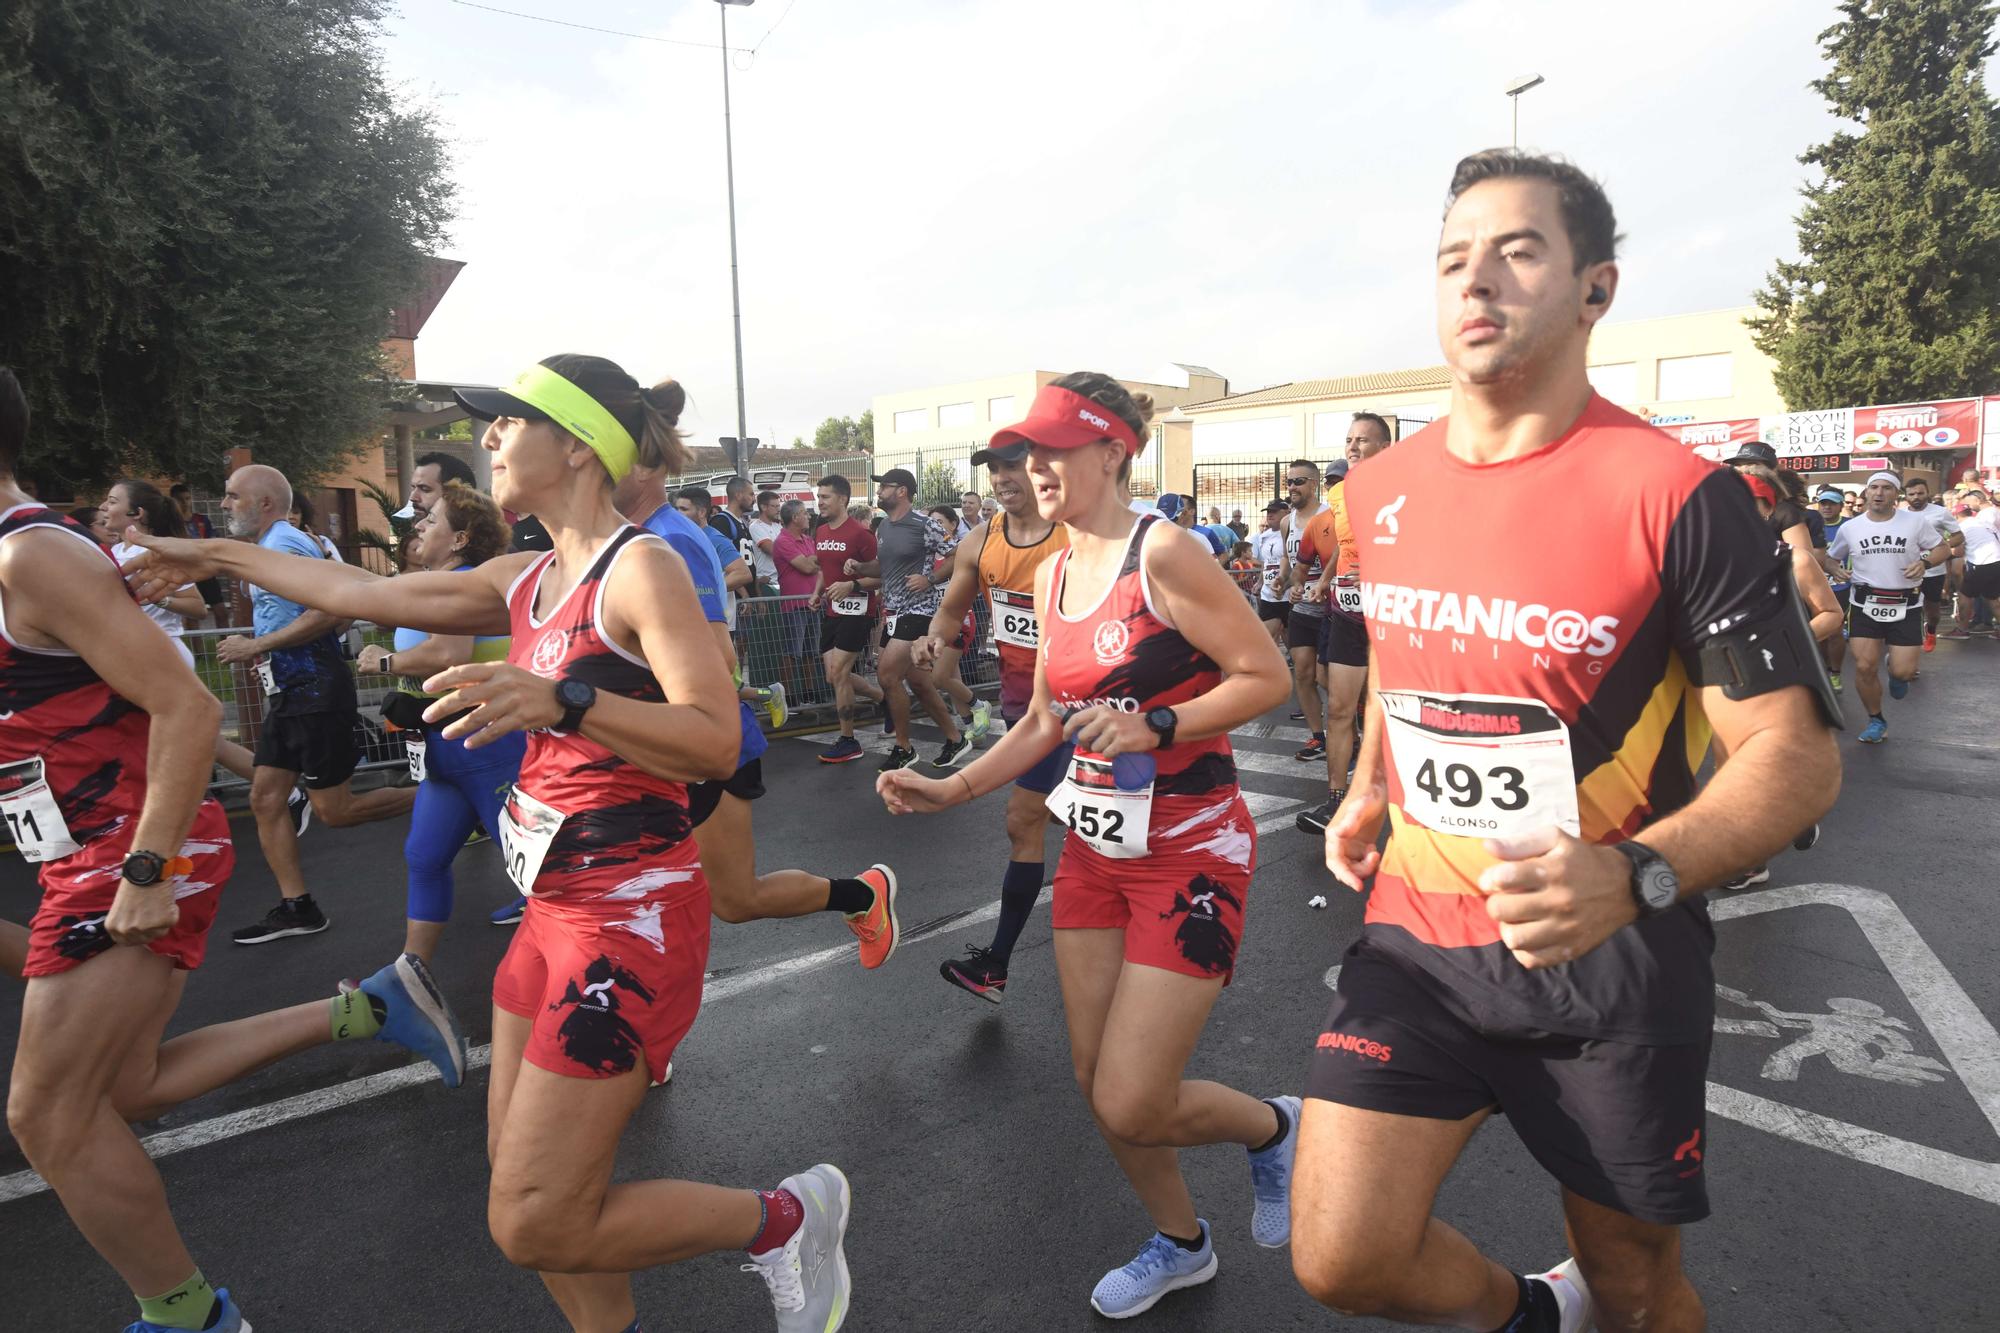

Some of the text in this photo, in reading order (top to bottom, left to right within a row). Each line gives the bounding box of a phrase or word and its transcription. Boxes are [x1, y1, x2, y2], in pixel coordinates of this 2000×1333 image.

[1079, 409, 1110, 431] SPORT
[1789, 412, 1846, 425] XXVIII
[816, 540, 847, 551] adidas
[1859, 536, 1907, 549] UCAM
[1861, 548, 1906, 556] UNIVERSIDAD
[1340, 592, 1360, 606] 480
[838, 601, 861, 611] 402
[1871, 607, 1897, 617] 060
[1416, 758, 1530, 811] 493
[1440, 815, 1498, 830] ALONSO
